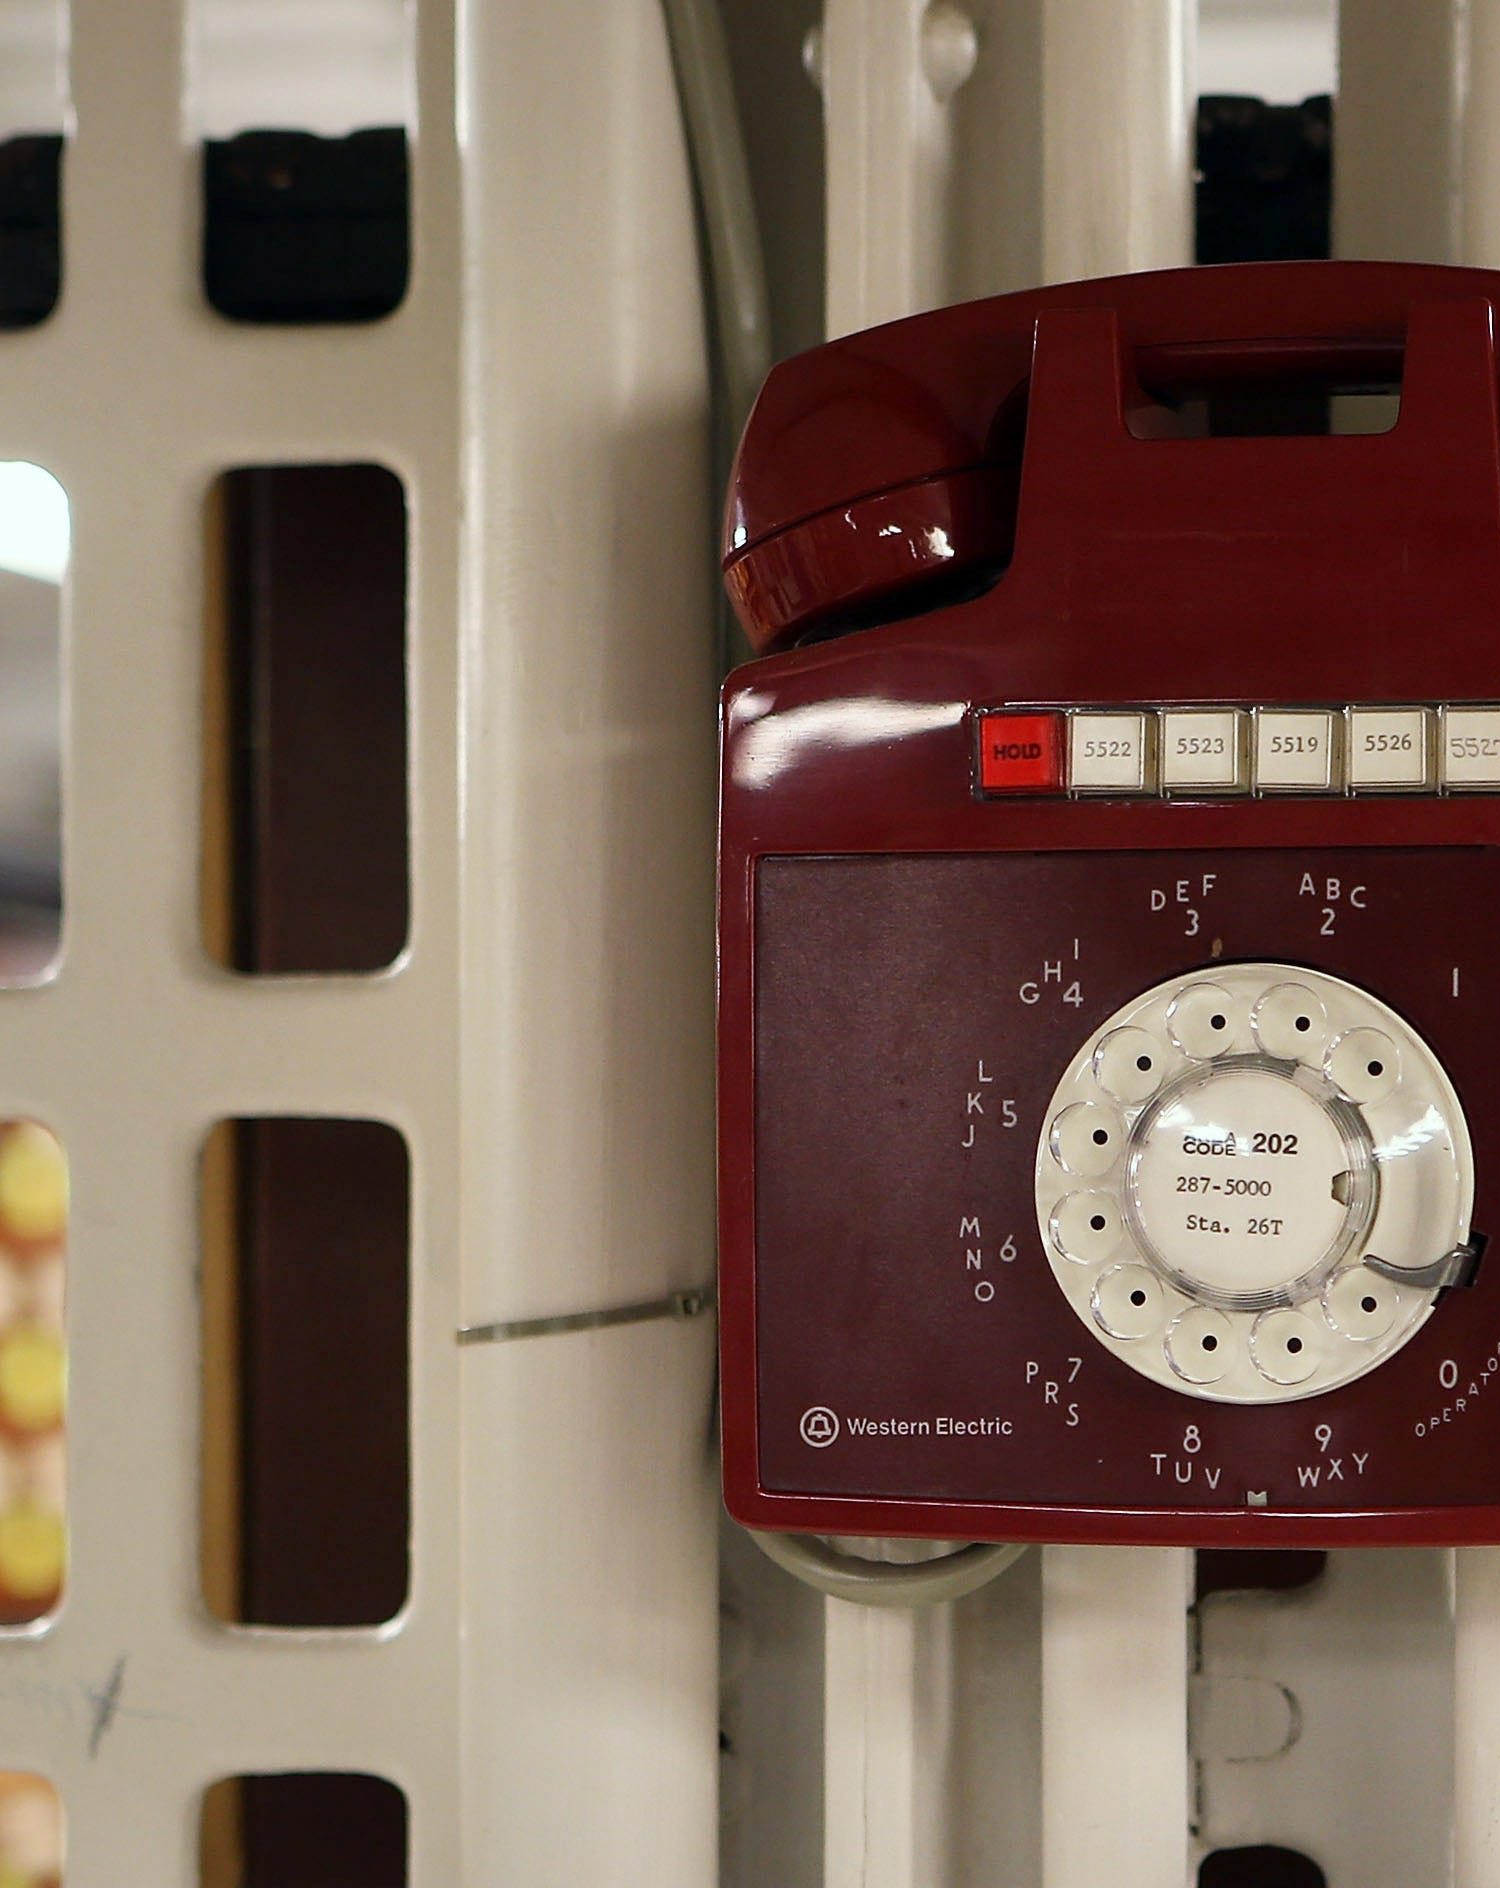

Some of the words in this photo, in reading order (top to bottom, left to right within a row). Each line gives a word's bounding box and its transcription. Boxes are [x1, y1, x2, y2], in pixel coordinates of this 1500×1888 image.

[993, 742, 1042, 761] HOLD
[1083, 740, 1132, 758] 5522
[1176, 737, 1226, 755] 5523
[1270, 736, 1319, 754] 5519
[1363, 733, 1412, 752] 5526
[1184, 909, 1199, 936] 3
[1320, 907, 1336, 935] 2
[1063, 981, 1084, 1008] 4
[1002, 1100, 1018, 1128] 5
[1183, 1141, 1236, 1156] CODE
[1252, 1132, 1299, 1155] 202
[1176, 1176, 1272, 1197] 287-5000
[1186, 1214, 1230, 1234] Sta.
[1247, 1218, 1283, 1236] 26T
[1000, 1234, 1018, 1262] 6
[1067, 1357, 1082, 1384] 7
[1439, 1359, 1458, 1389] 0
[847, 1417, 930, 1436] Western
[936, 1417, 1013, 1436] Electric
[1183, 1424, 1201, 1453] 8
[1314, 1424, 1332, 1452] 9
